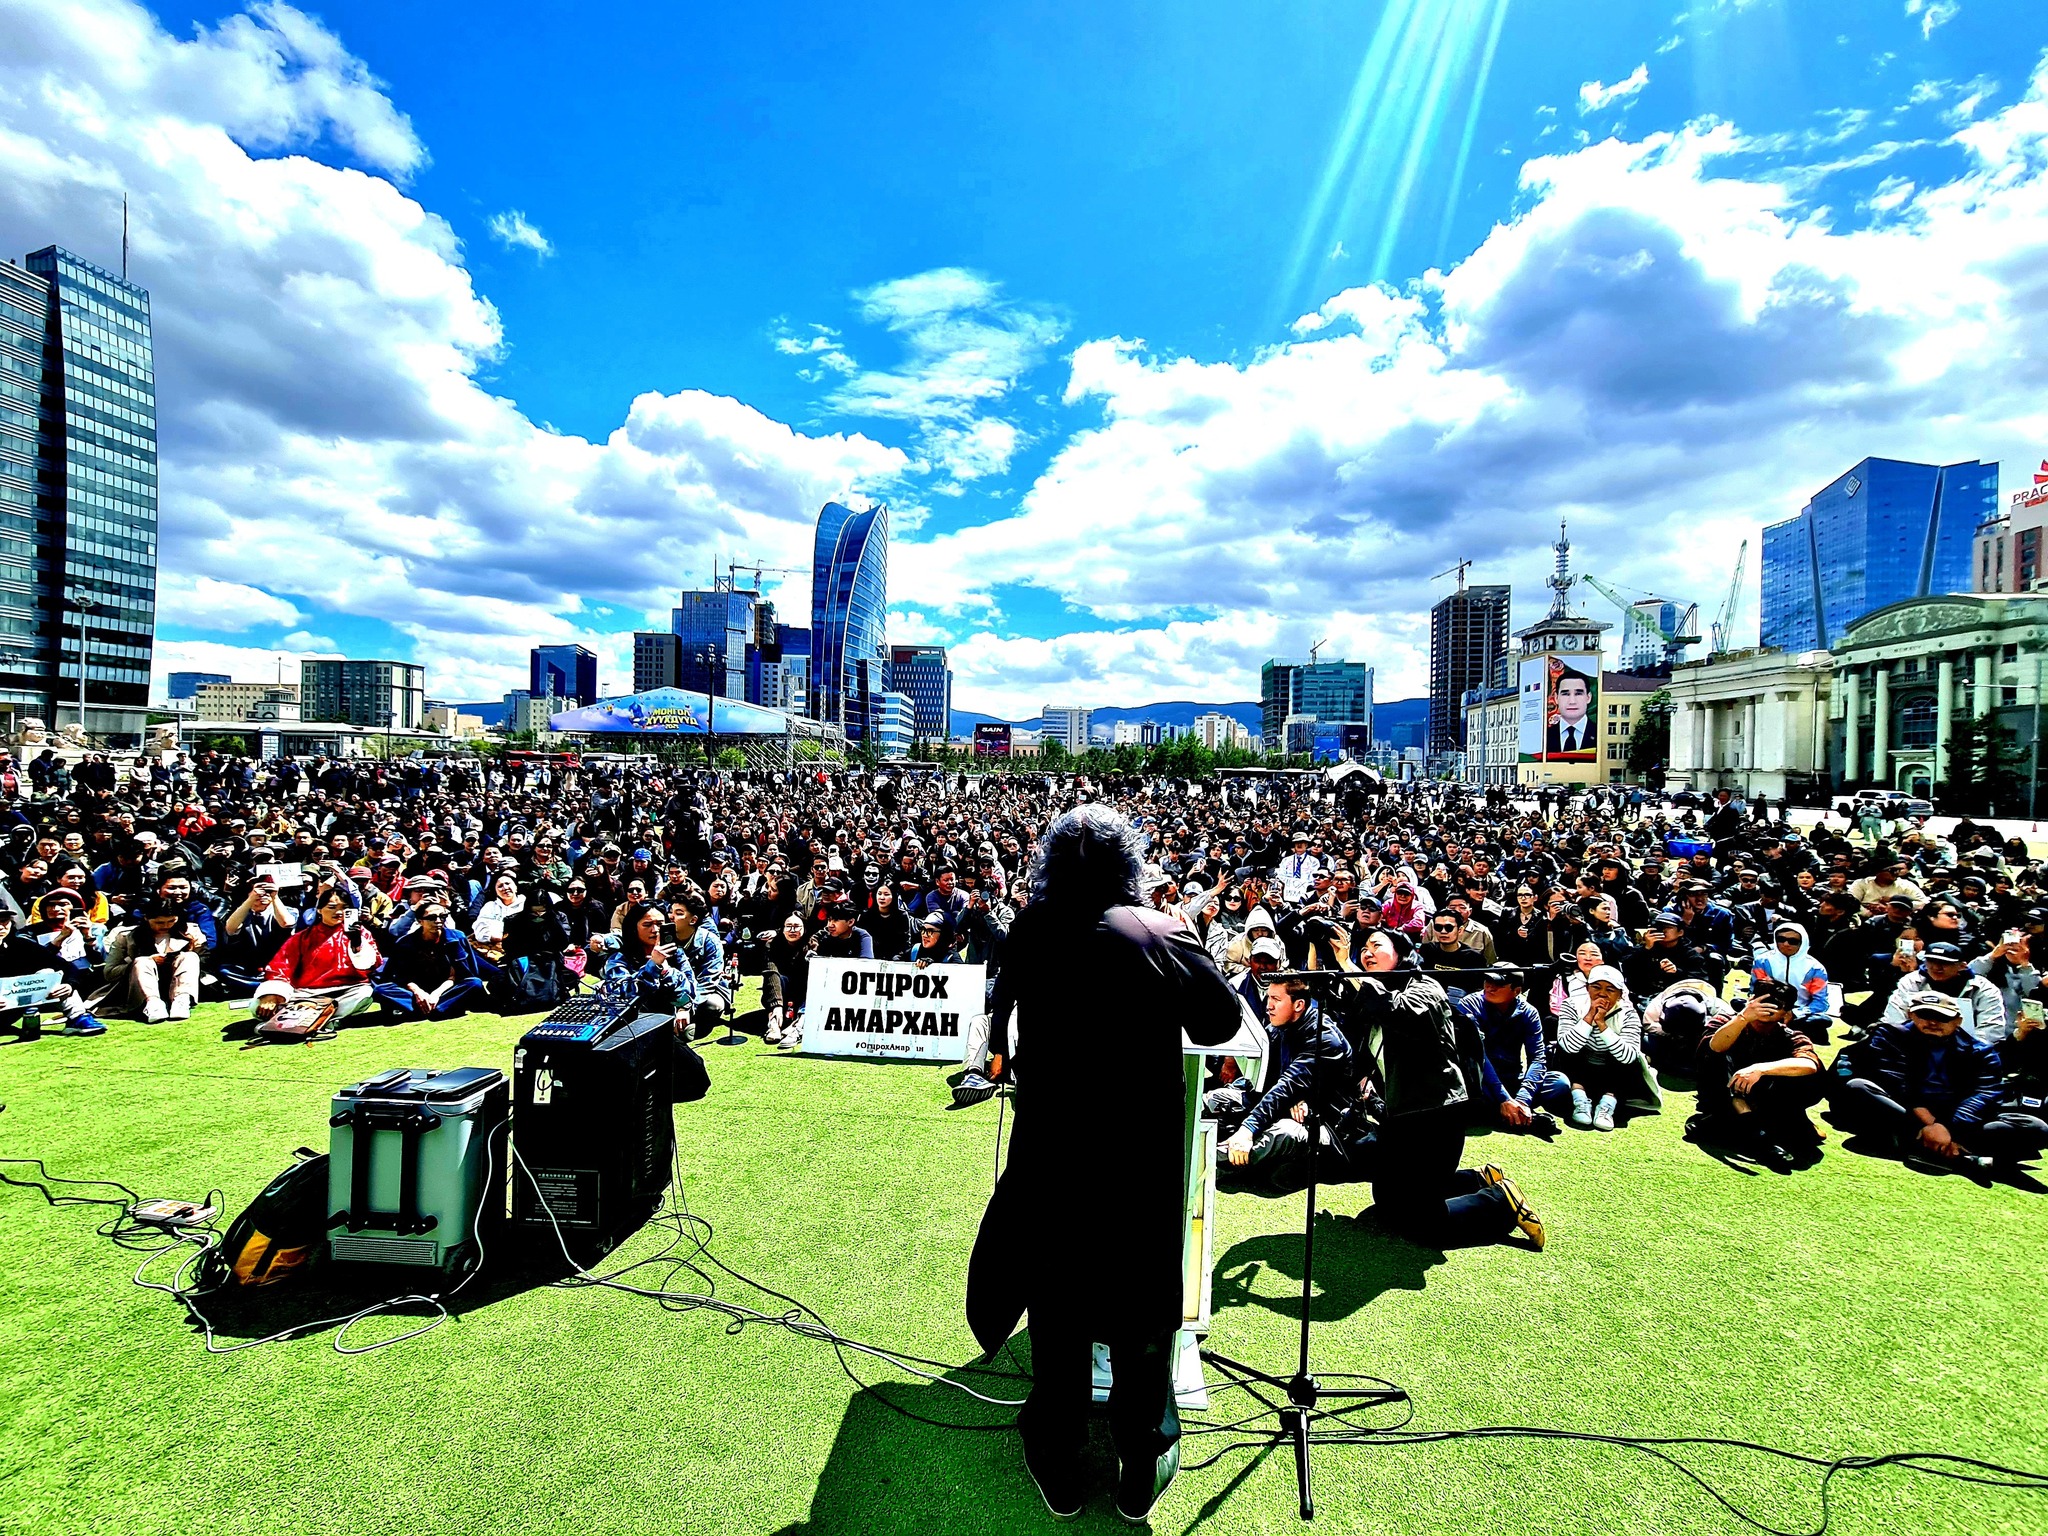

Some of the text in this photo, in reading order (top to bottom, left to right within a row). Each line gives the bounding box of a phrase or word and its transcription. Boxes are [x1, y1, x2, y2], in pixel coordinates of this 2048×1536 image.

[652, 708, 691, 716] МОНГОЛ
[841, 971, 949, 1001] ОГЦРОХ
[824, 1007, 960, 1037] АМАРХАН
[855, 1041, 924, 1053] #ОгцрохАмарн
